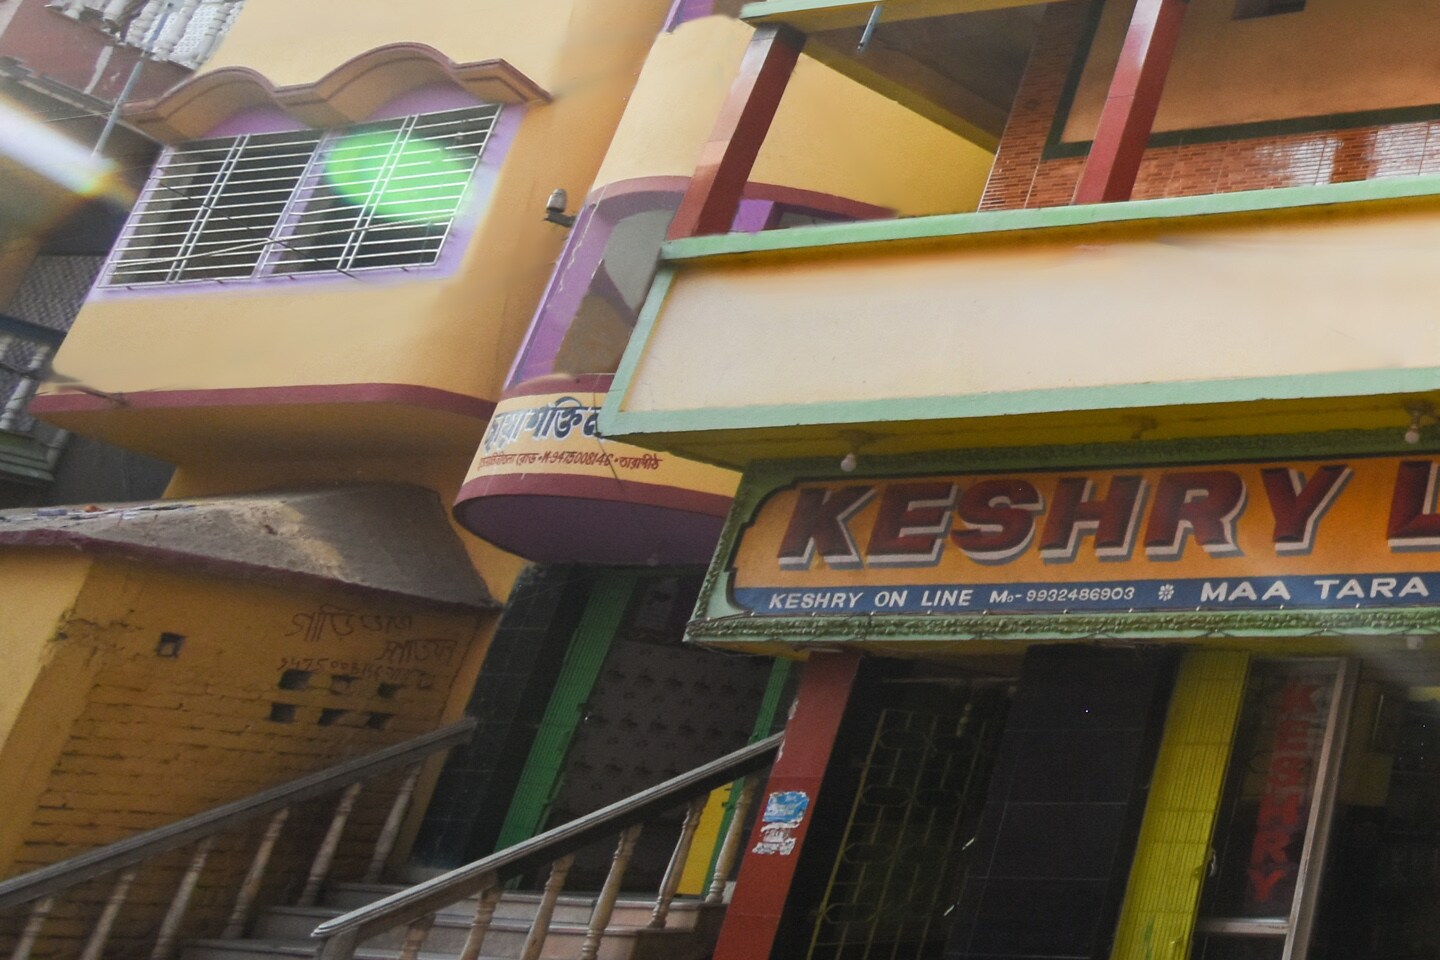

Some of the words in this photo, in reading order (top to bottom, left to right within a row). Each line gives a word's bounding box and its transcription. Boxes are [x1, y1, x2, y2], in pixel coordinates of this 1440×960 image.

[777, 464, 1352, 571] KESHRY
[769, 591, 863, 610] KESHRY
[874, 590, 906, 608] ON
[921, 589, 974, 607] LINE
[1200, 580, 1292, 602] MAA
[1313, 576, 1430, 600] TARA
[1248, 682, 1319, 903] KESHRY
